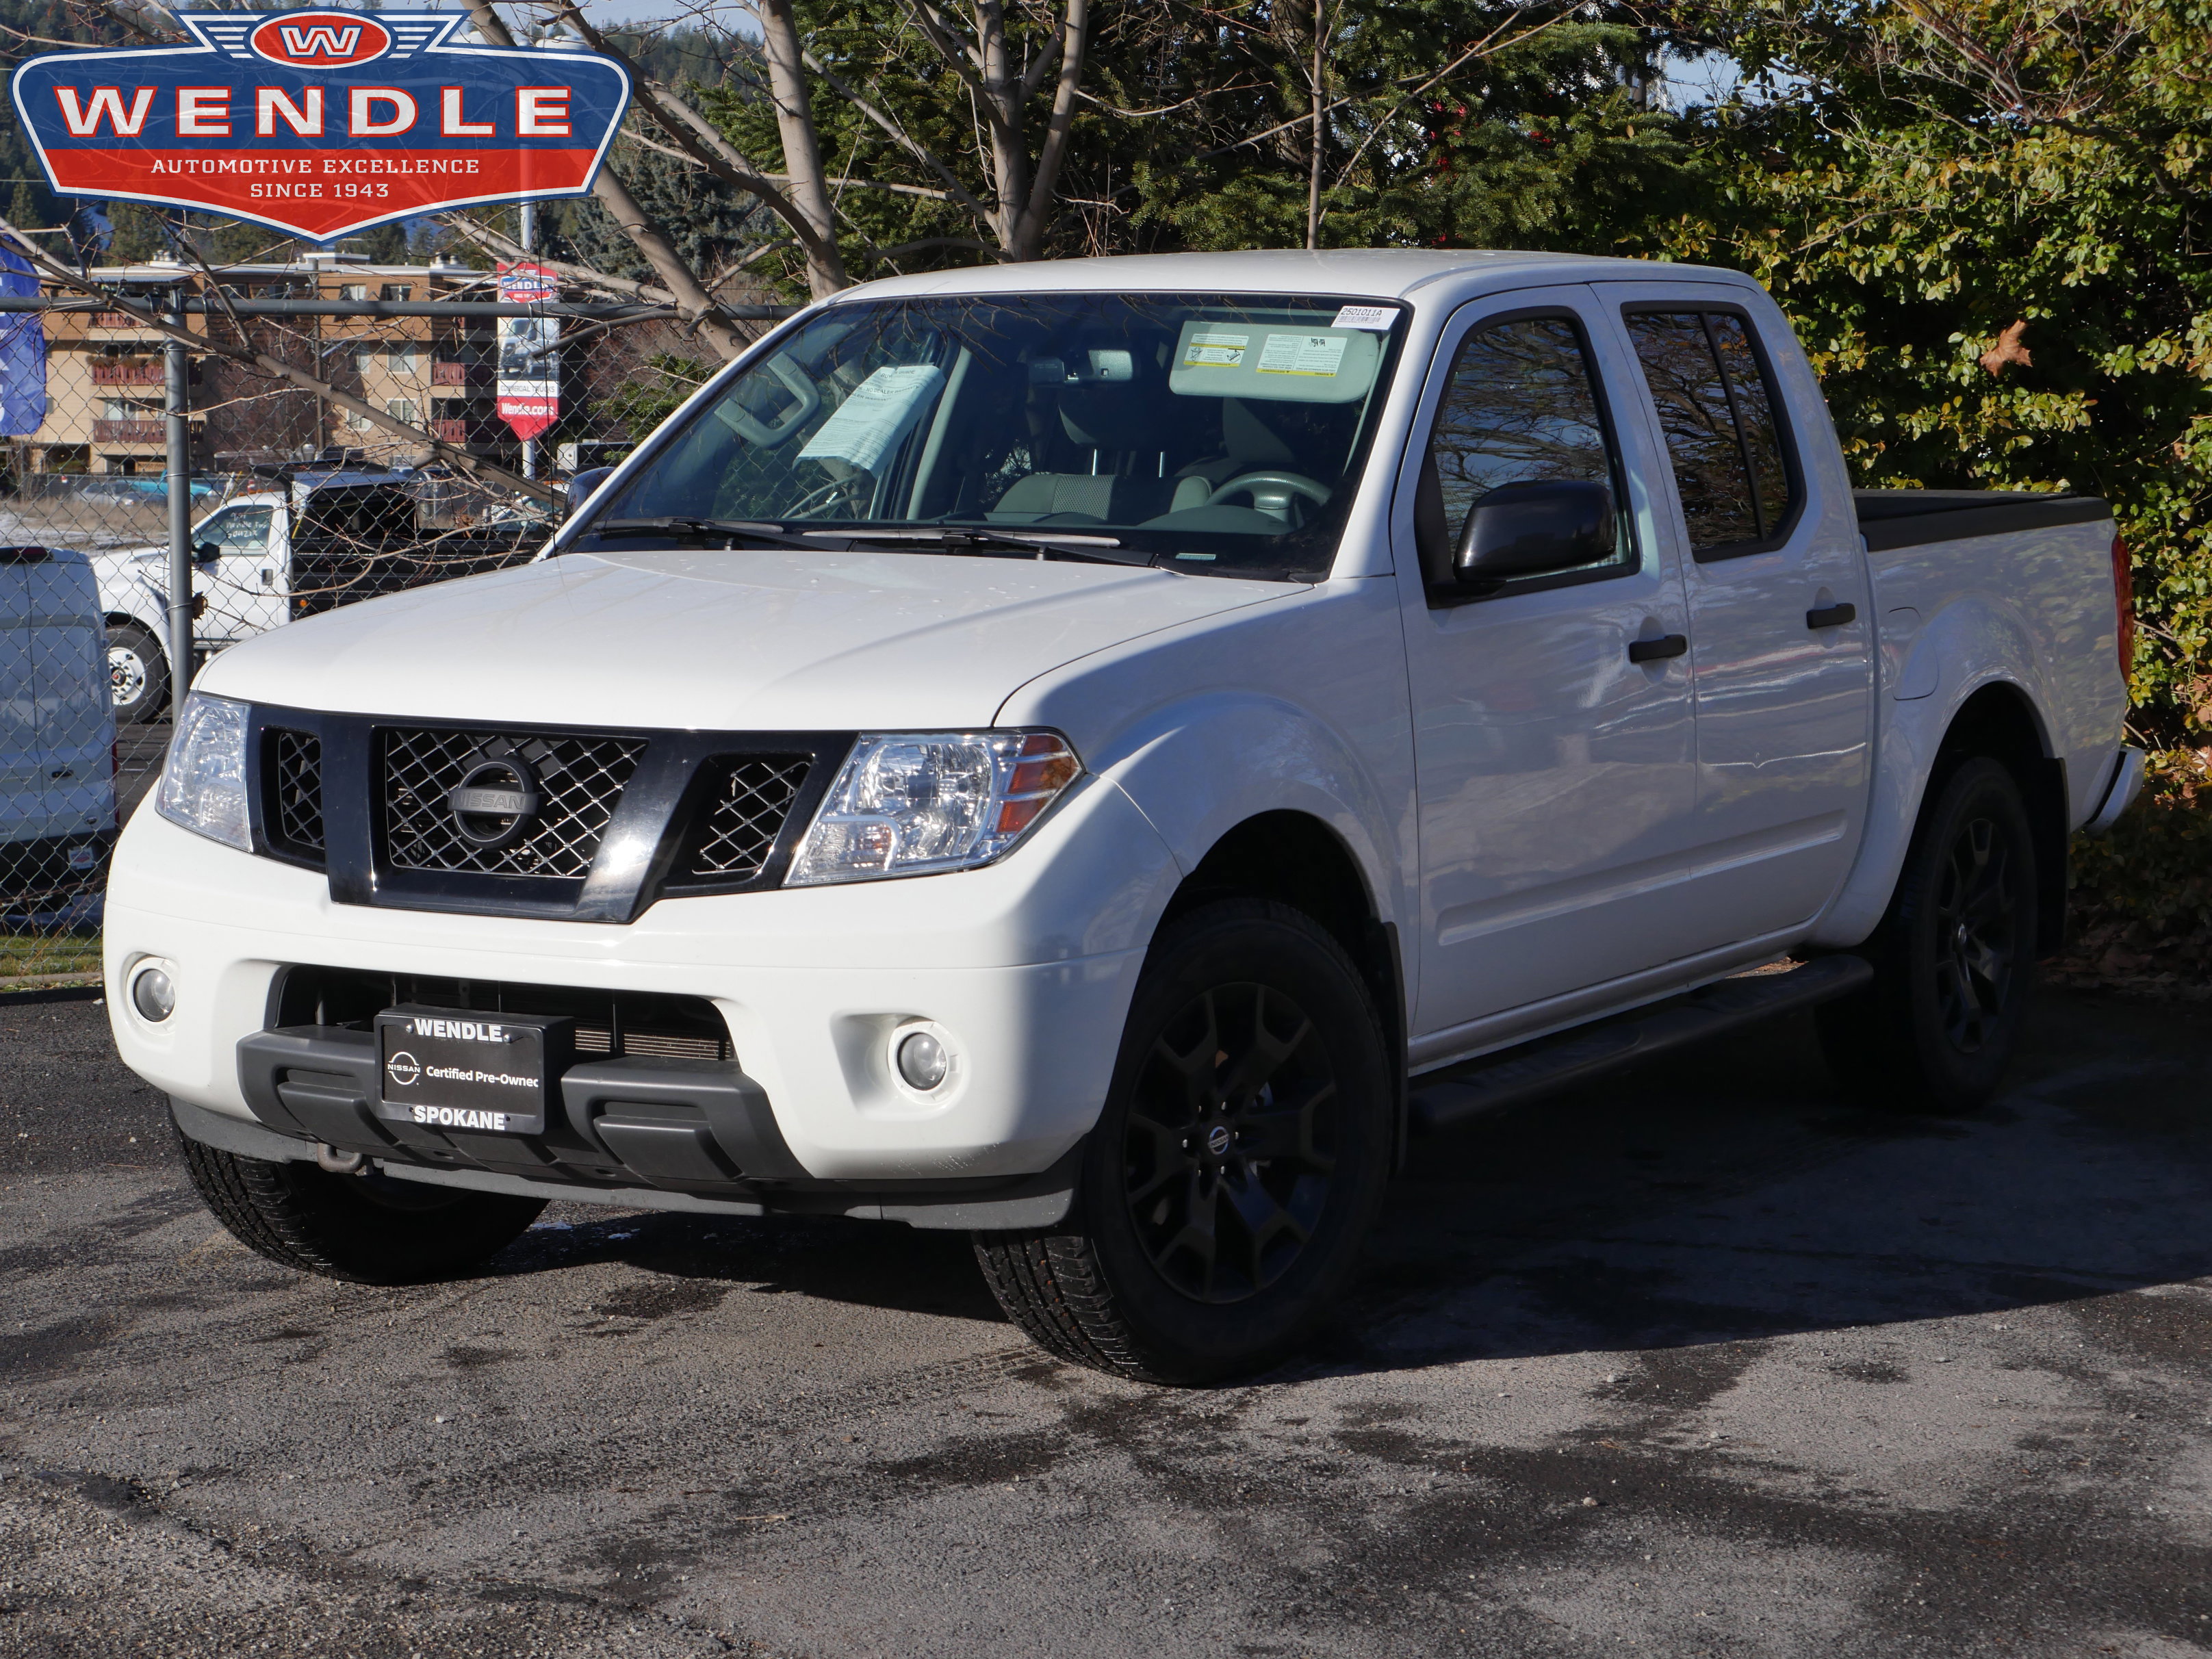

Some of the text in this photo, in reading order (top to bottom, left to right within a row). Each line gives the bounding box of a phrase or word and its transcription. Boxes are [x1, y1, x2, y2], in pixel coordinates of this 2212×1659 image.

[1341, 308, 1382, 317] 2501011A
[452, 793, 526, 810] NISSAN
[413, 1018, 504, 1042] WENDLE
[387, 1064, 420, 1073] NISSAN
[426, 1066, 474, 1081] Certified
[413, 1105, 506, 1131] SPOKANE
